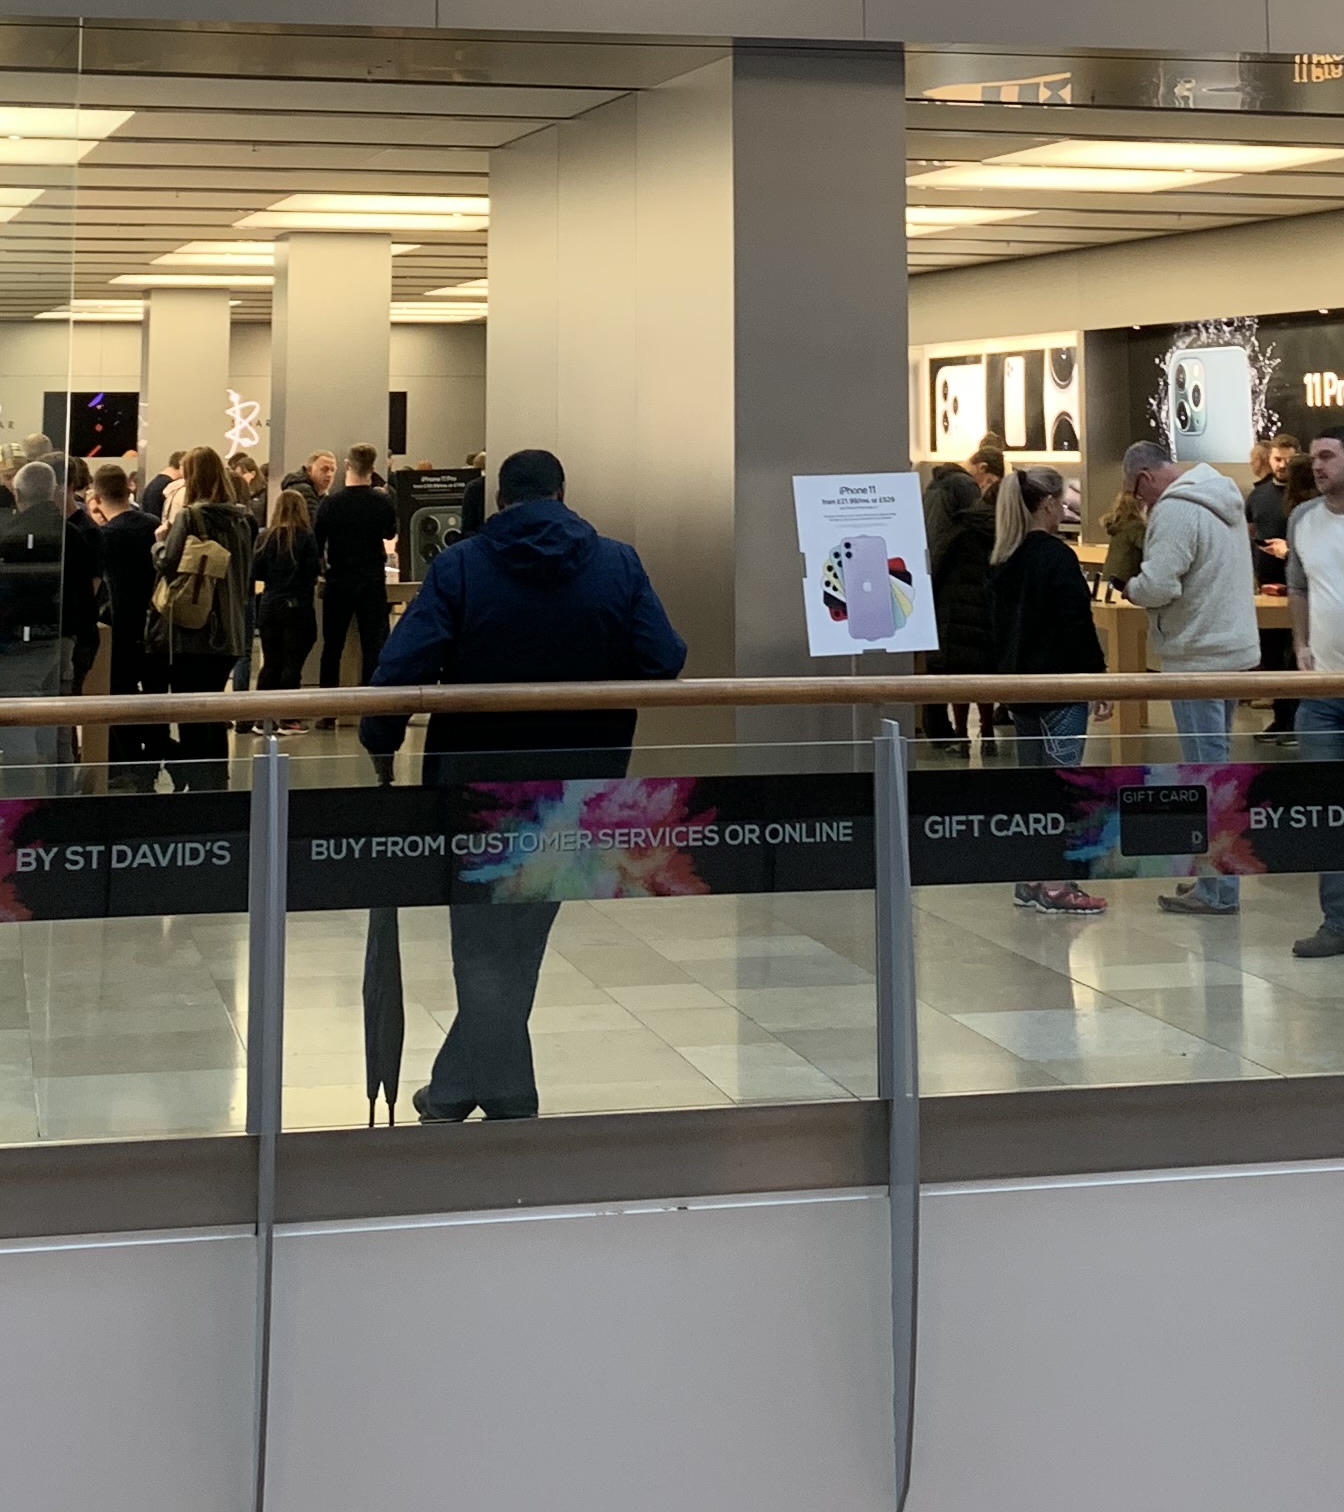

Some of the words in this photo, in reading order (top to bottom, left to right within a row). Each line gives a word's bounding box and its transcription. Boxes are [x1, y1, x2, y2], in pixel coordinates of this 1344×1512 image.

[1304, 373, 1322, 407] 11
[1122, 791, 1154, 803] GIFT
[1159, 790, 1199, 802] CARD
[924, 815, 986, 839] GIFT
[989, 813, 1065, 836] CARD
[1250, 807, 1285, 828] BY
[1290, 806, 1323, 827] ST
[16, 848, 58, 872] BY
[64, 846, 103, 870] ST
[112, 841, 231, 869] DAVID'S
[311, 840, 366, 860] BUY
[371, 836, 445, 858] FROM
[451, 831, 591, 856] CUSTOMER
[598, 826, 719, 849] SERVICES
[724, 825, 760, 845] OR
[765, 822, 853, 844] ONLINE
